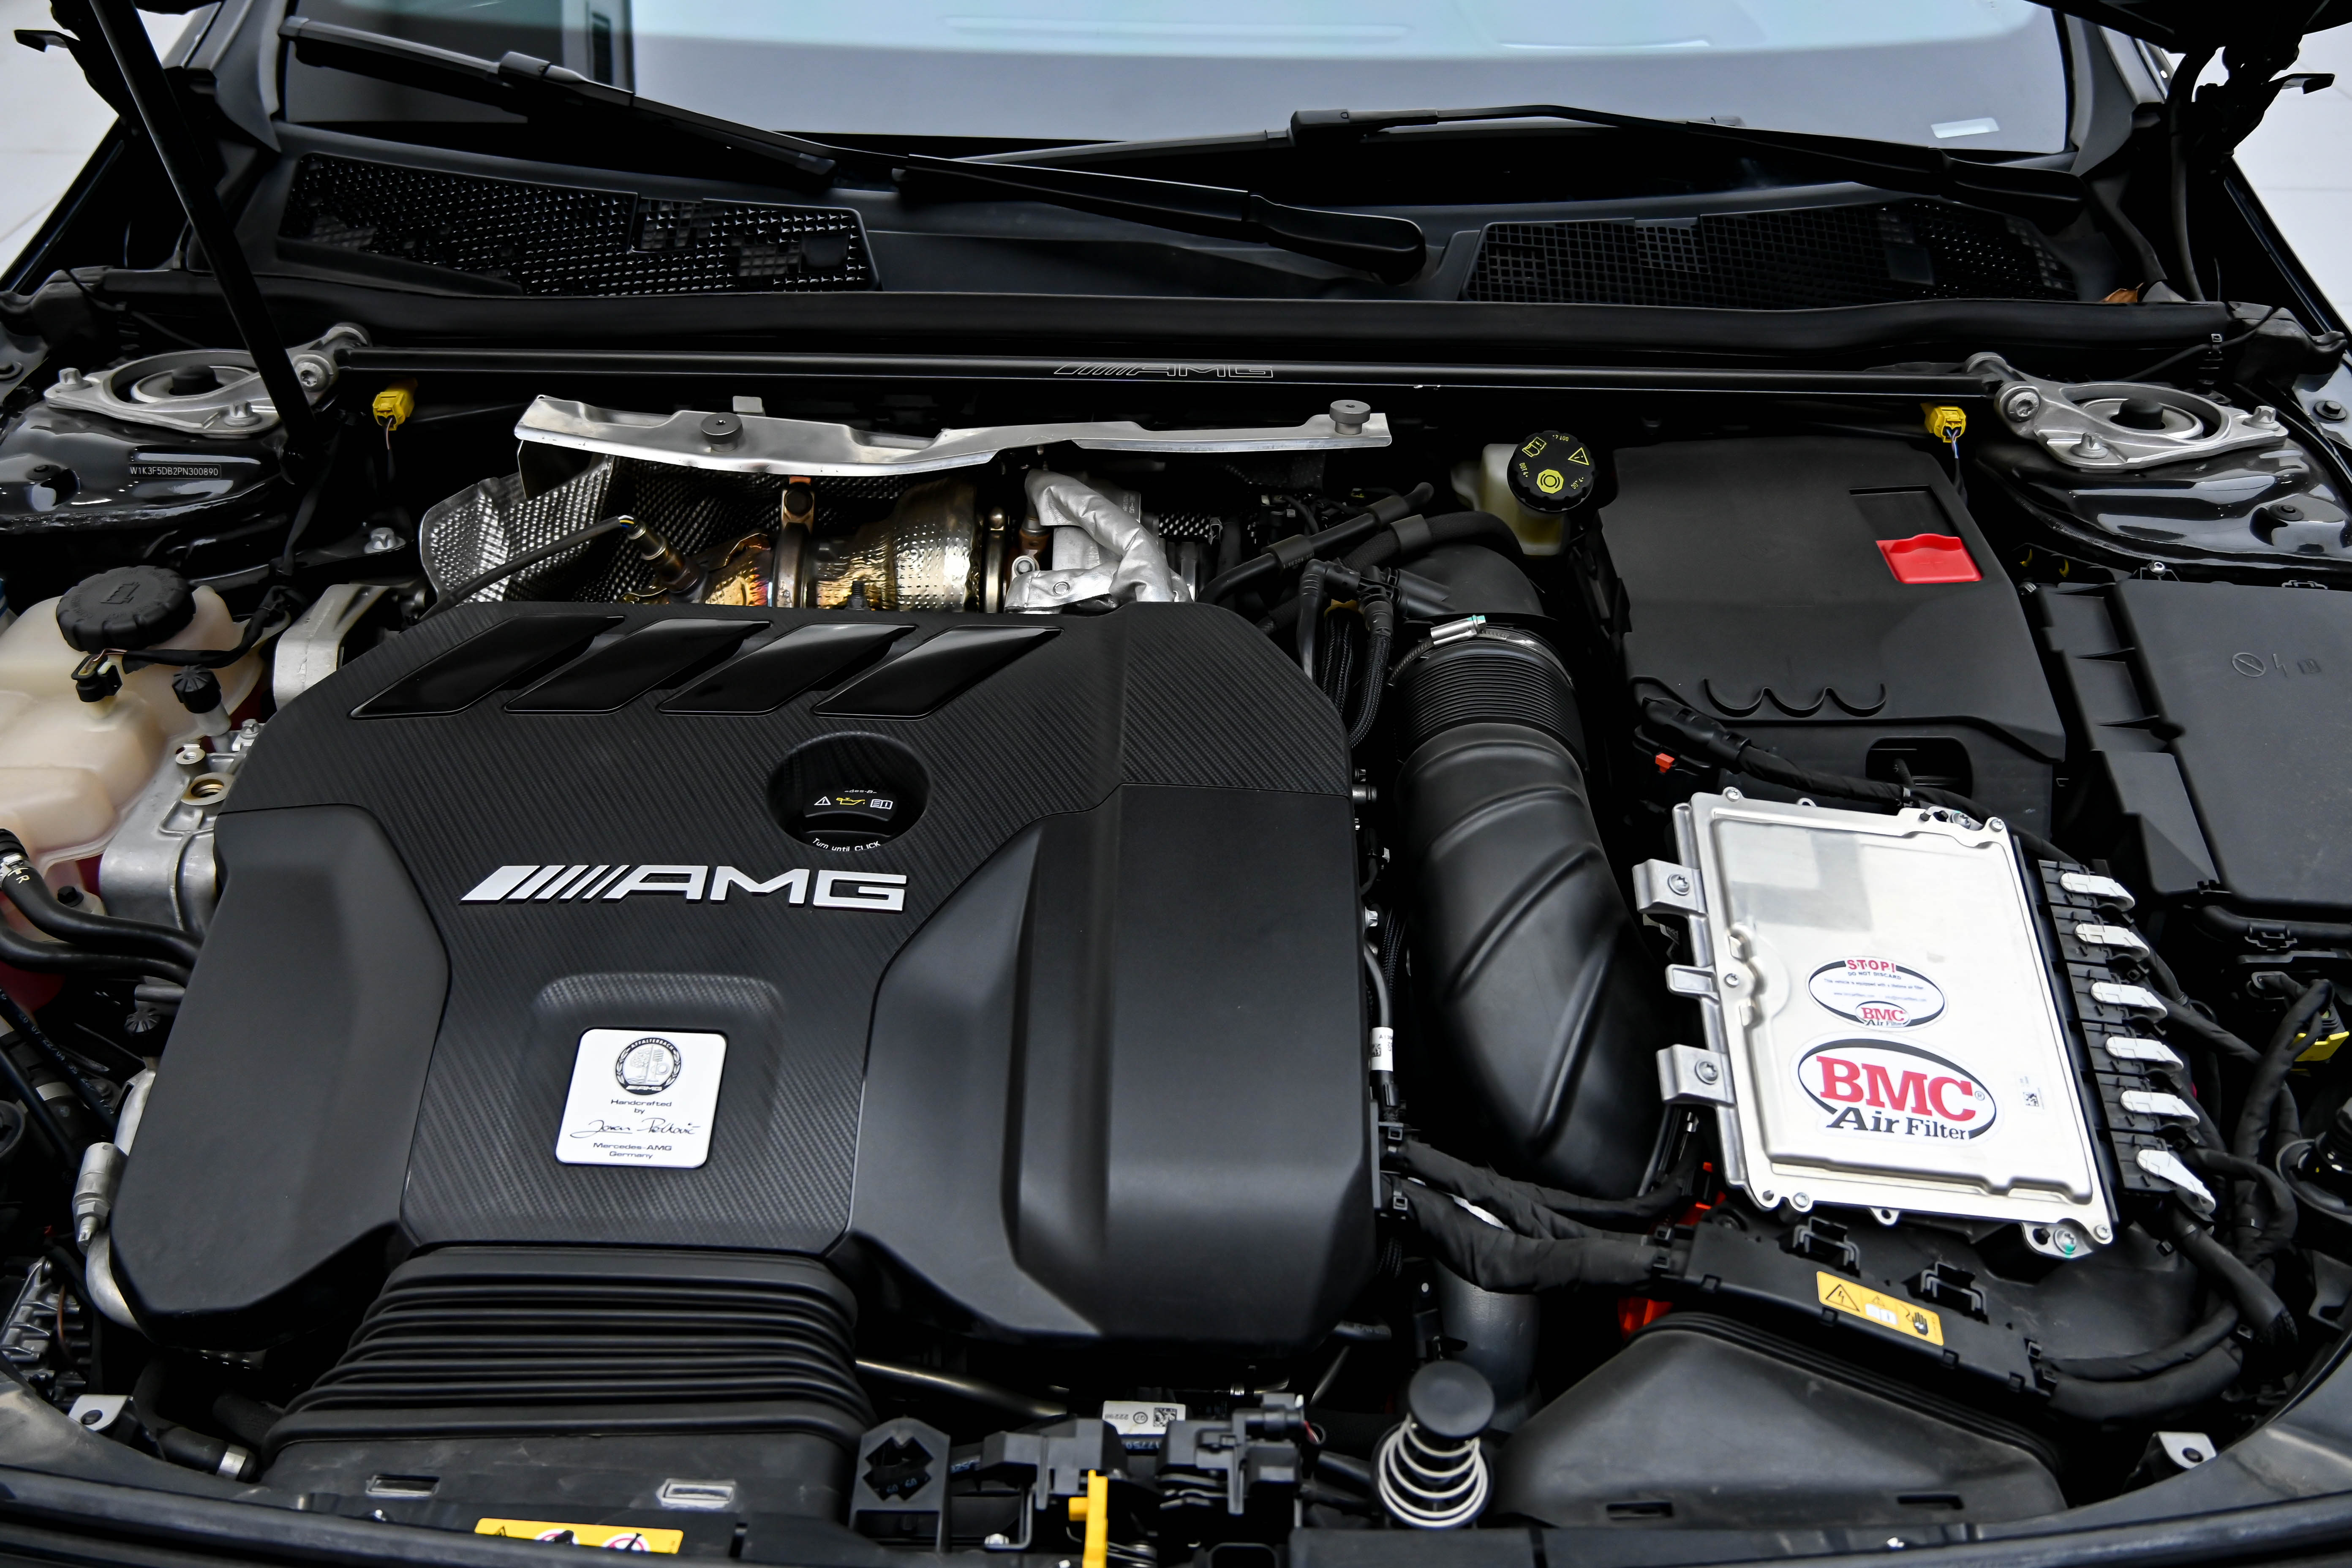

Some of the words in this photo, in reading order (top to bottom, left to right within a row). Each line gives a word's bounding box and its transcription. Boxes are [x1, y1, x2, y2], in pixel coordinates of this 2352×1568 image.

[1127, 363, 1274, 378] AMG
[130, 466, 218, 476] W1K3F5DB2PN300890
[813, 838, 829, 849] Turn
[855, 841, 881, 851] CLICK
[601, 865, 907, 912] AMG
[1847, 959, 1896, 973] STOP!
[1861, 1007, 1905, 1021] BMC
[1816, 1055, 1976, 1122] BMC
[1826, 1106, 1900, 1134] Air
[1905, 1117, 1966, 1140] Filter
[593, 1143, 672, 1151] Mercedes-AMG
[609, 1151, 653, 1159] Germany
